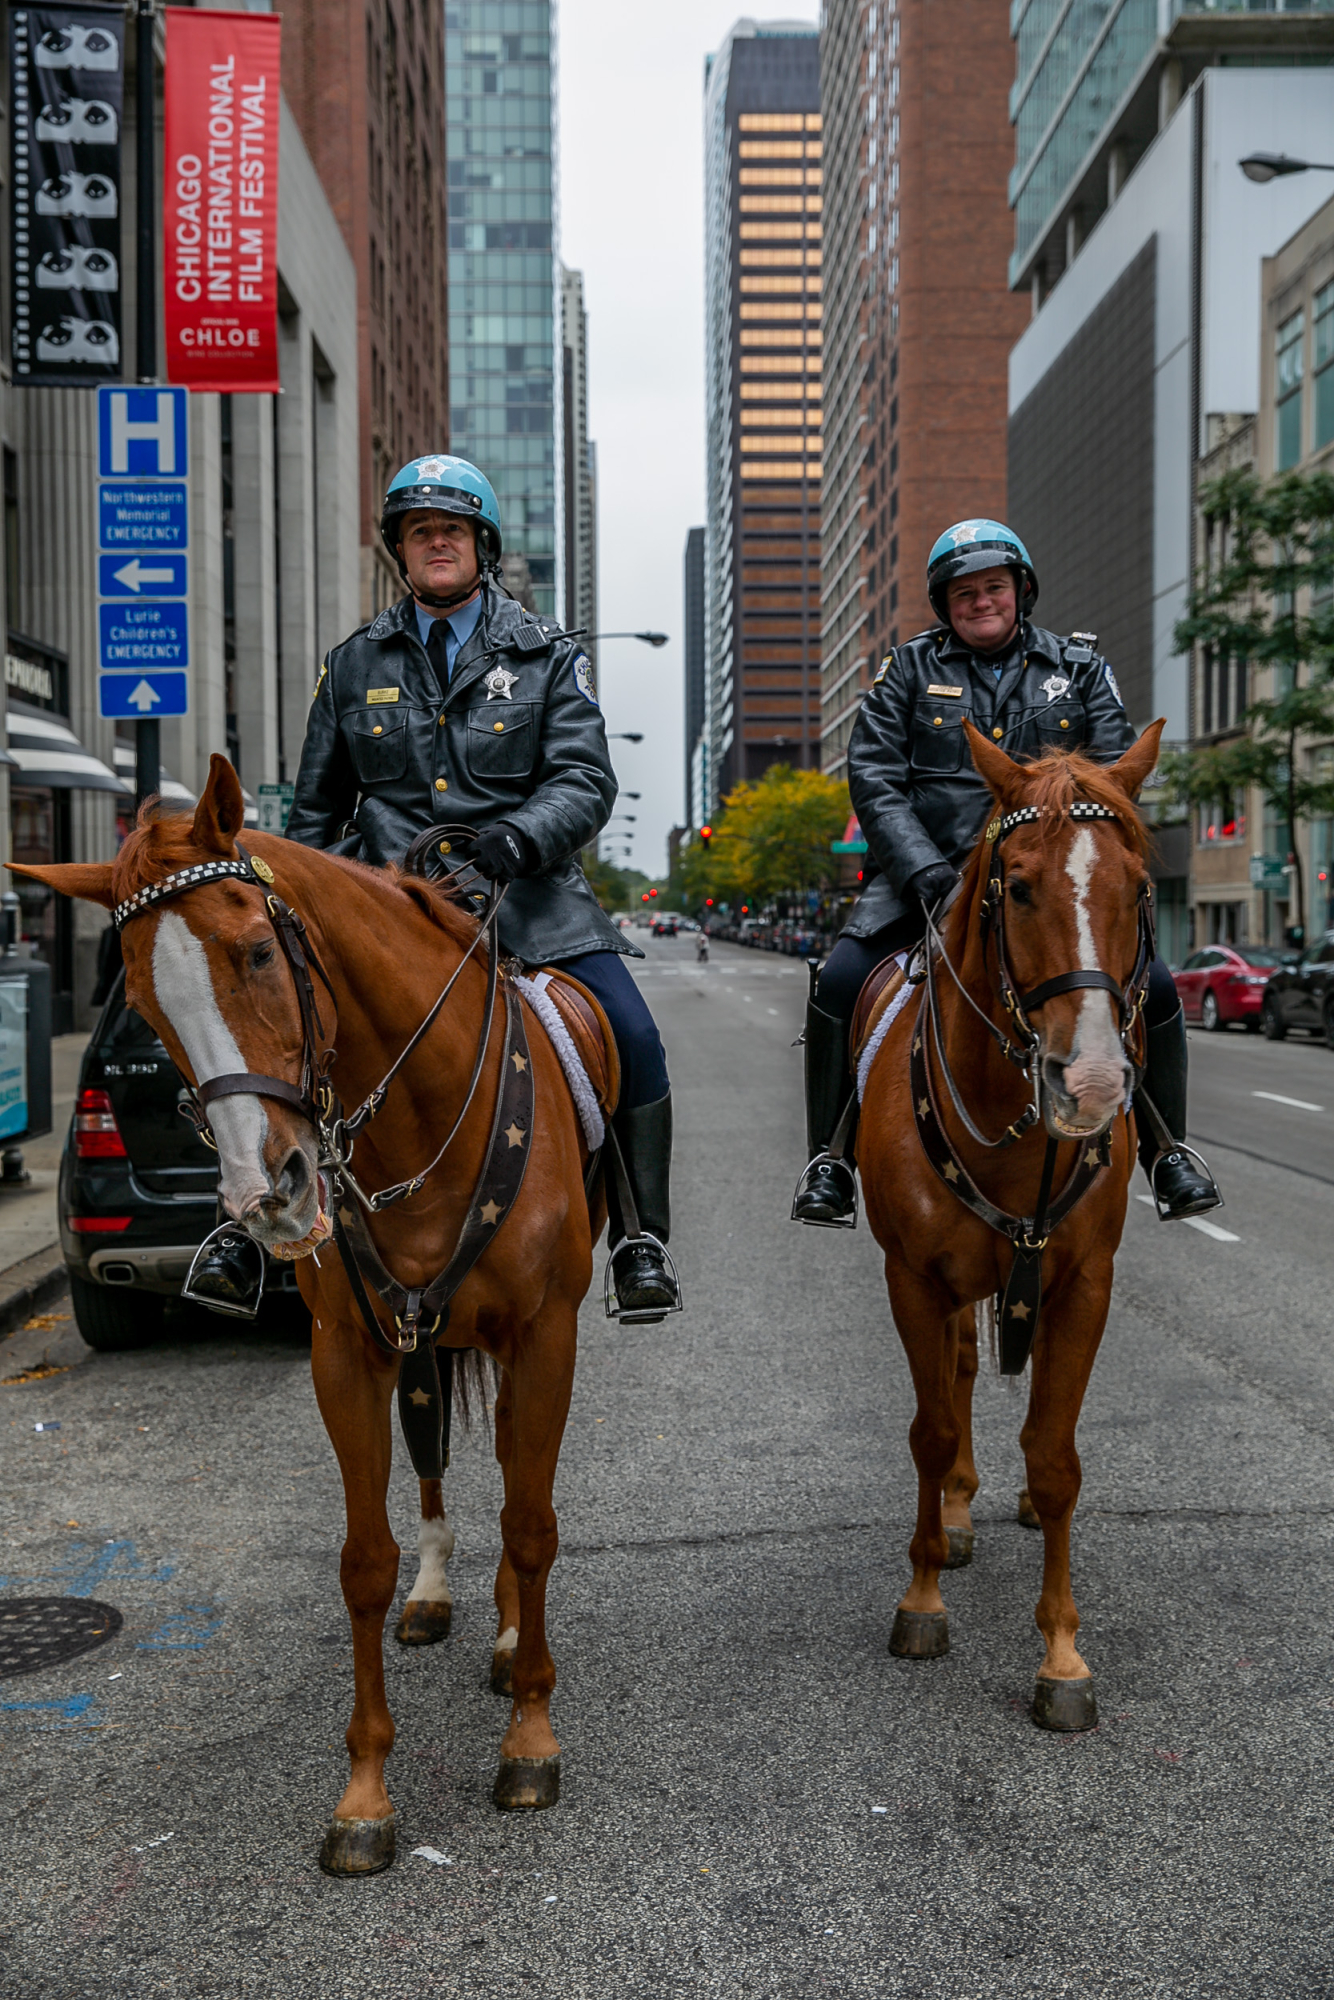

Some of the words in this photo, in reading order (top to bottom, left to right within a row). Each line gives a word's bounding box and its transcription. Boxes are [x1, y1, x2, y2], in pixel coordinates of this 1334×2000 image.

[239, 75, 266, 218] FESTIVAL
[208, 54, 235, 302] INTERNATIONAL
[176, 154, 202, 302] CHICAGO
[238, 228, 264, 302] FILM
[179, 327, 260, 347] CHLOE
[110, 392, 176, 473] H
[102, 489, 184, 504] Northwestern
[116, 507, 171, 522] Memorial
[106, 525, 181, 541] EMERGENCY
[125, 608, 161, 624] Lurie
[110, 625, 177, 641] Children's
[106, 643, 181, 659] EMERGENCY
